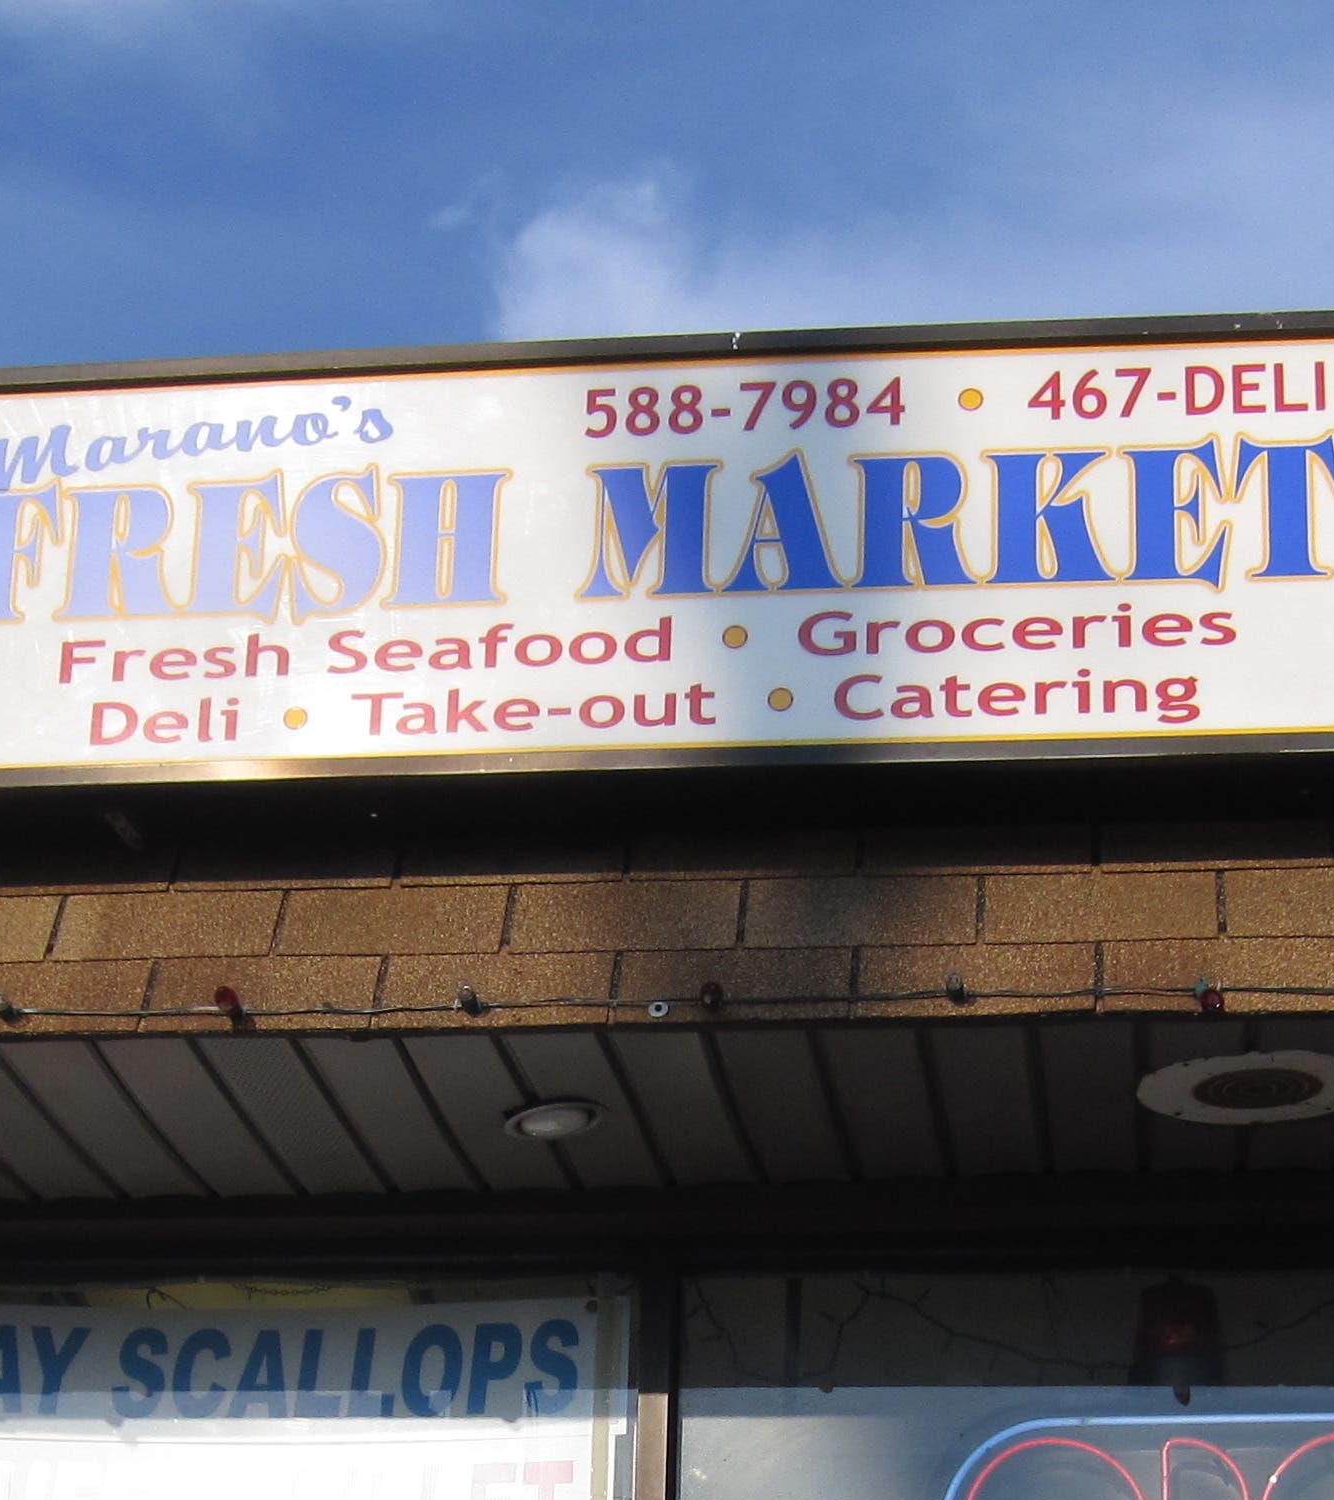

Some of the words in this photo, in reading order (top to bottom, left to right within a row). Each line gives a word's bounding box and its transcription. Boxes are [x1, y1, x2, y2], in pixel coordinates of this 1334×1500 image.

[585, 376, 906, 438] 588-7984
[1028, 361, 1327, 421] 467-DELI
[58, 633, 291, 685] Fresh
[327, 615, 673, 675] Seafood
[798, 603, 1238, 657] Groceries
[90, 697, 240, 746] Deli
[351, 682, 717, 738] Take-out
[834, 669, 1201, 723] Catering
[111, 1319, 580, 1419] SCALLOPS
